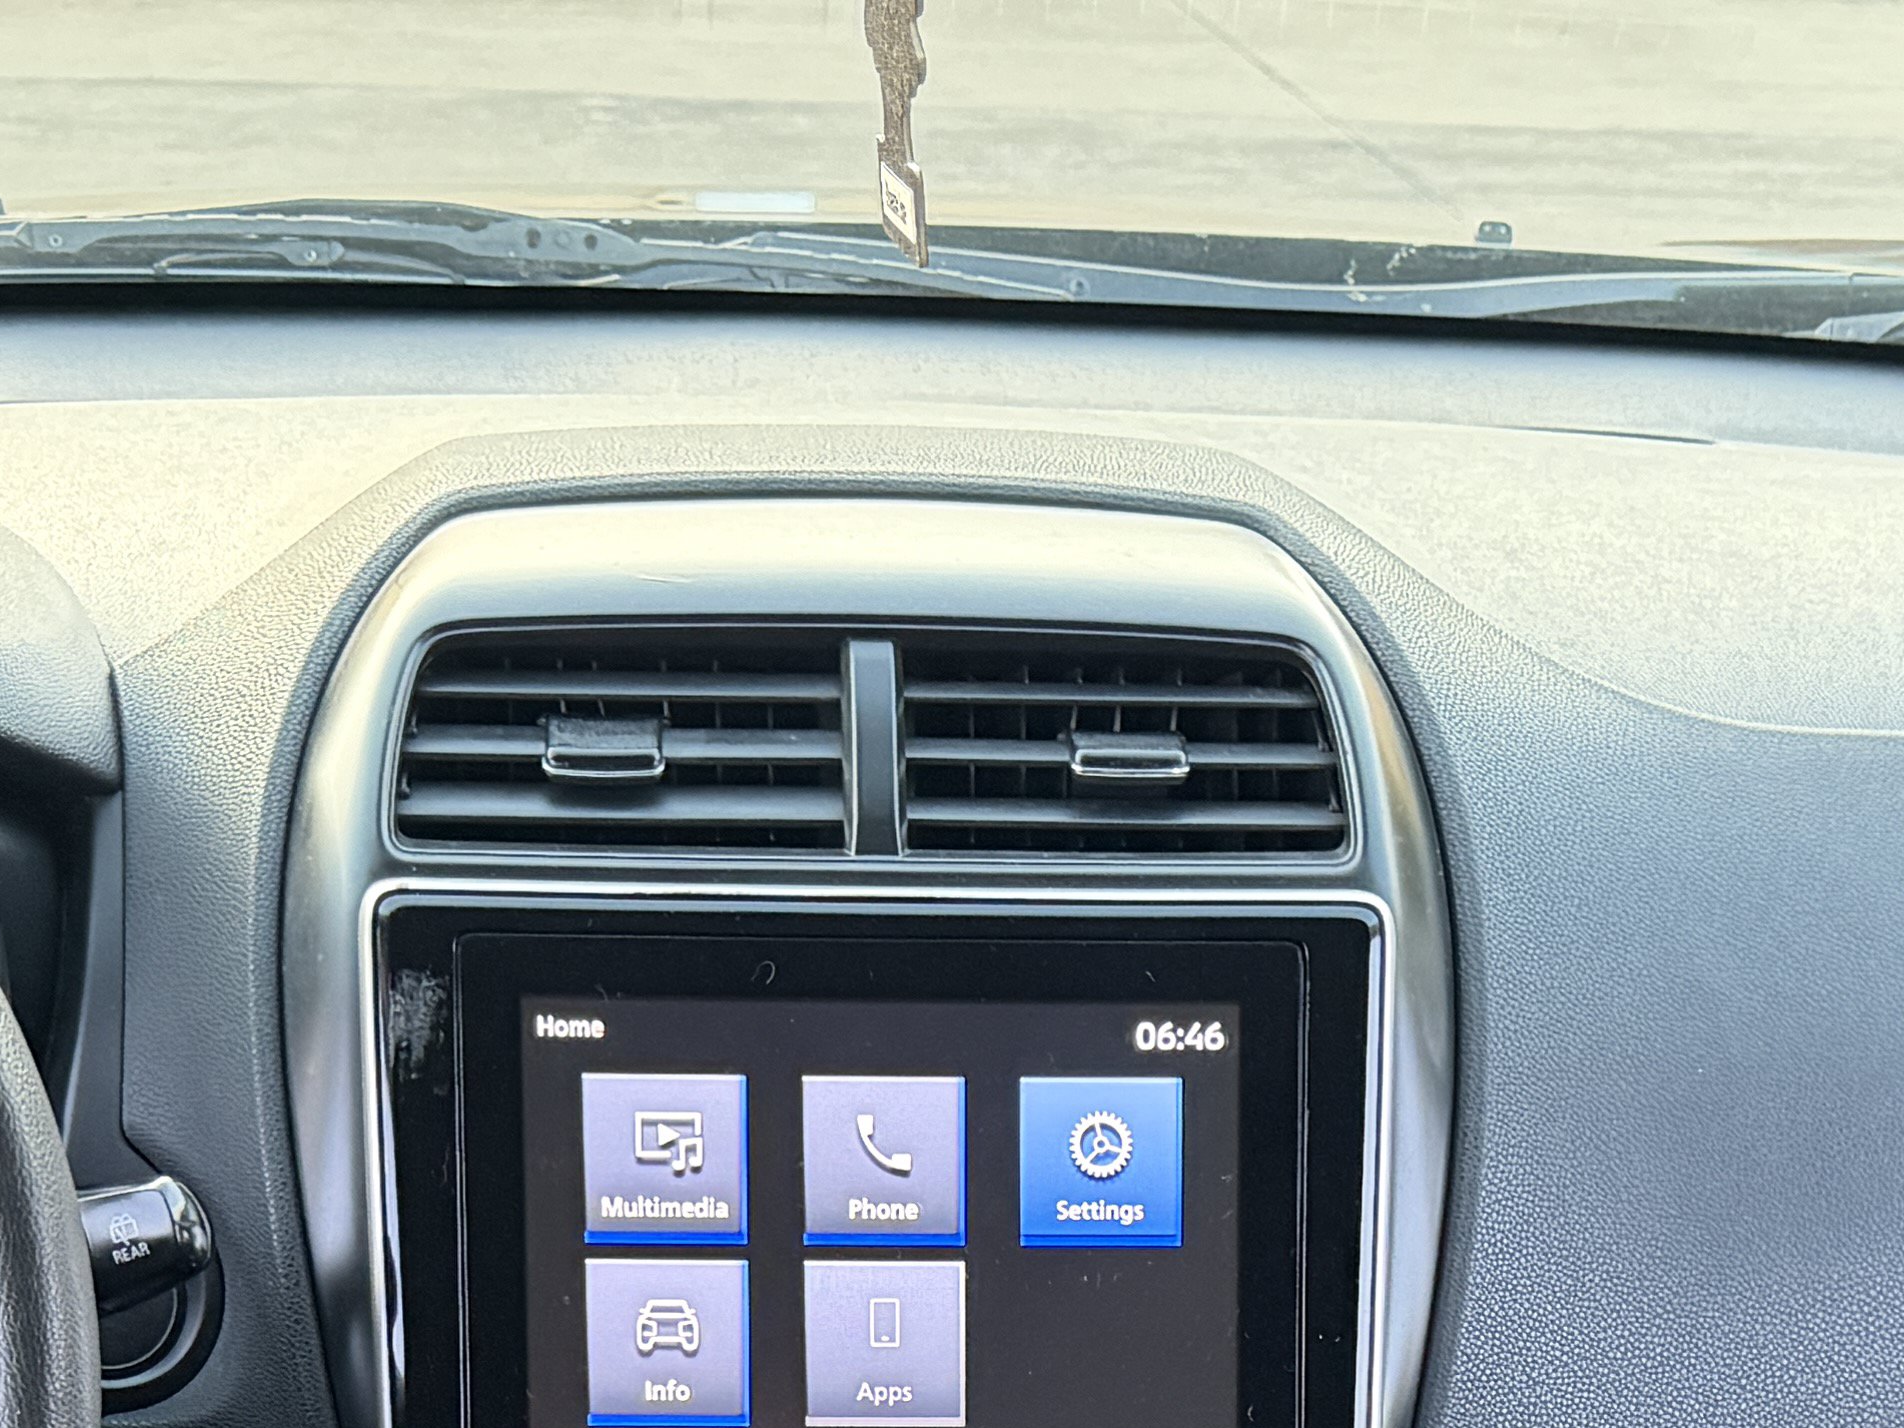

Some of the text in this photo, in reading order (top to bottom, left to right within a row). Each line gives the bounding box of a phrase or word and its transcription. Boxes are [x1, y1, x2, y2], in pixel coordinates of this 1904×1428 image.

[535, 1015, 607, 1040] Home
[1135, 1021, 1226, 1053] 06:46
[600, 1196, 730, 1221] Multimedia
[848, 1198, 919, 1222] Phone
[1055, 1199, 1145, 1225] Settings
[112, 1242, 151, 1265] REAR
[644, 1378, 692, 1403] Info
[856, 1380, 913, 1406] Apps
